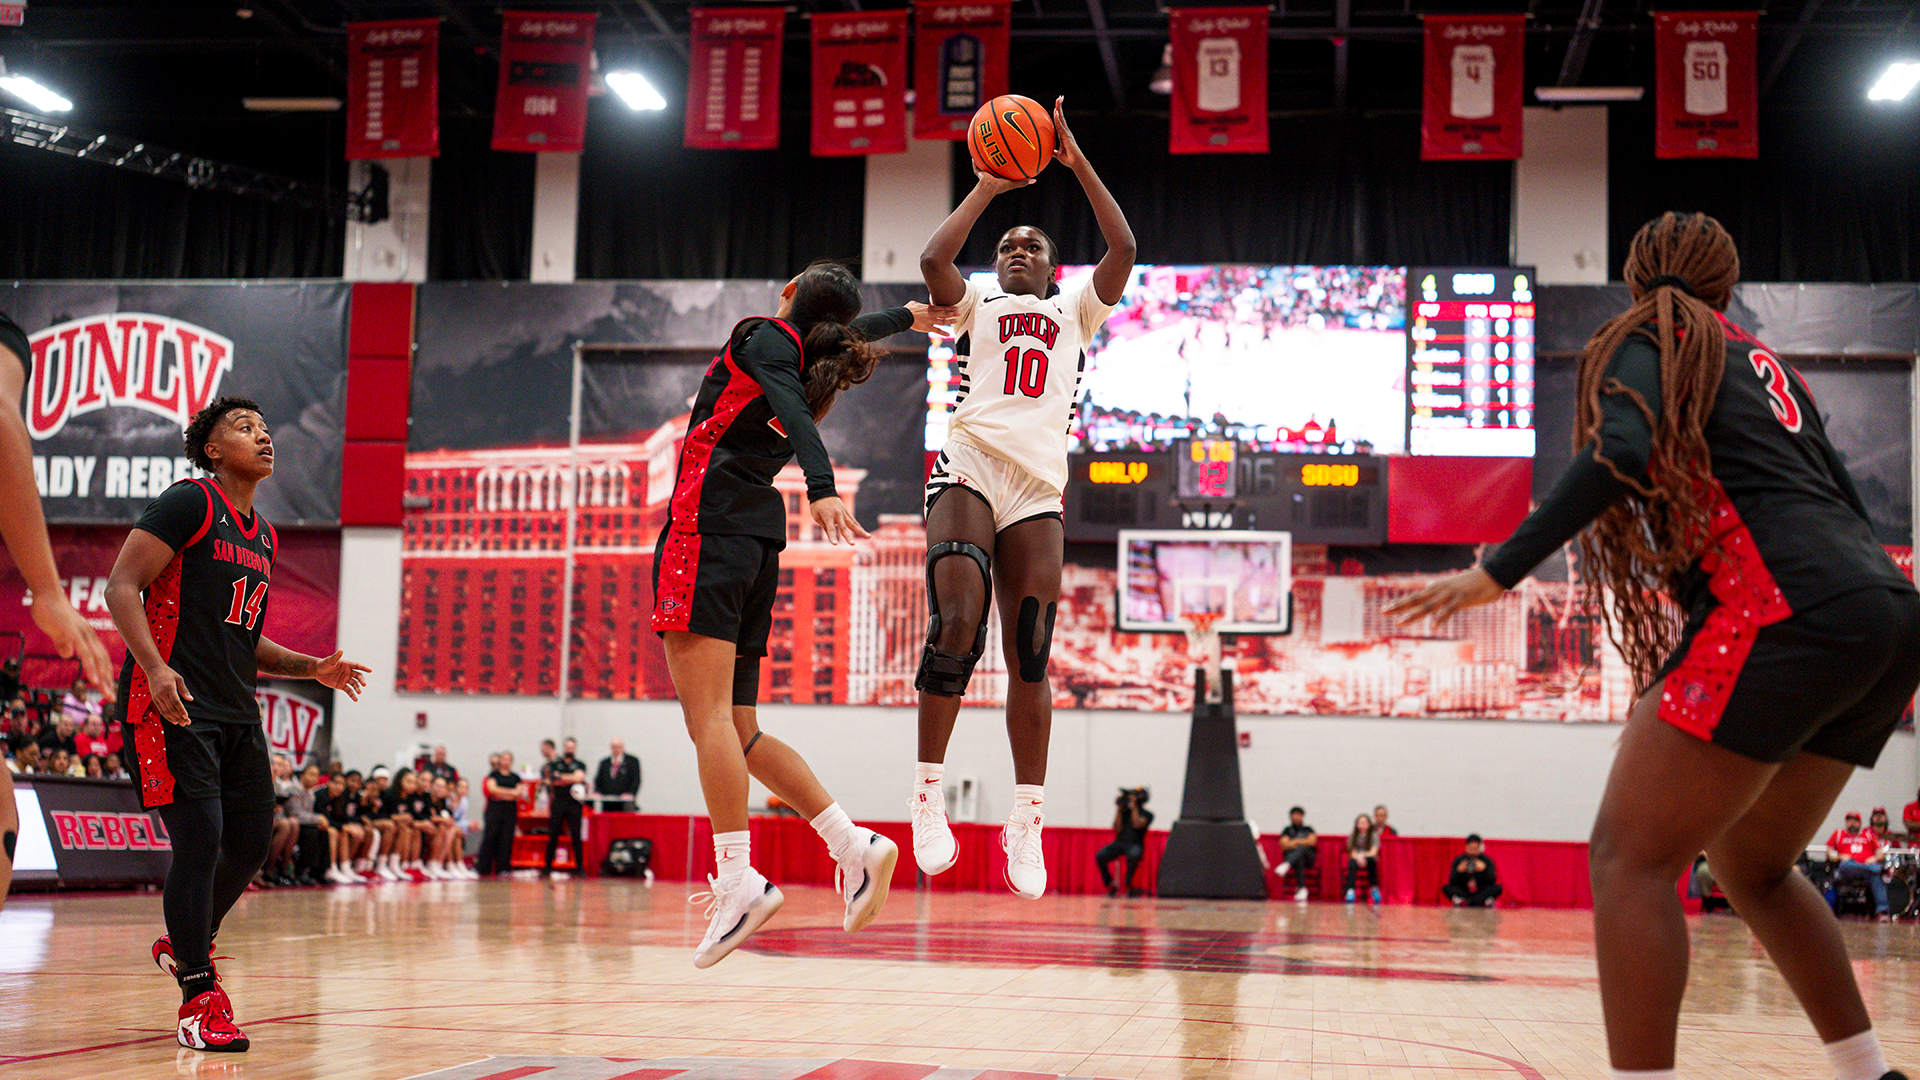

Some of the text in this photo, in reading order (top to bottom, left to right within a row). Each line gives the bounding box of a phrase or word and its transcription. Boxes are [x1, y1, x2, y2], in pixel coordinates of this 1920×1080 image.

[1465, 64, 1481, 85] 4
[1692, 60, 1721, 81] 50
[979, 118, 1009, 168] ELITE
[998, 312, 1060, 351] UNLV
[26, 312, 234, 441] UNLV
[1003, 346, 1049, 399] 10
[1748, 348, 1803, 434] 3
[33, 455, 97, 498] ADY
[1089, 461, 1149, 484] UNLV
[1199, 460, 1229, 498] 12
[1301, 464, 1359, 486] SDSU
[212, 538, 235, 564] SAN
[234, 544, 263, 573] DIEGO
[224, 575, 269, 631] 14
[50, 809, 173, 851] REBEL
